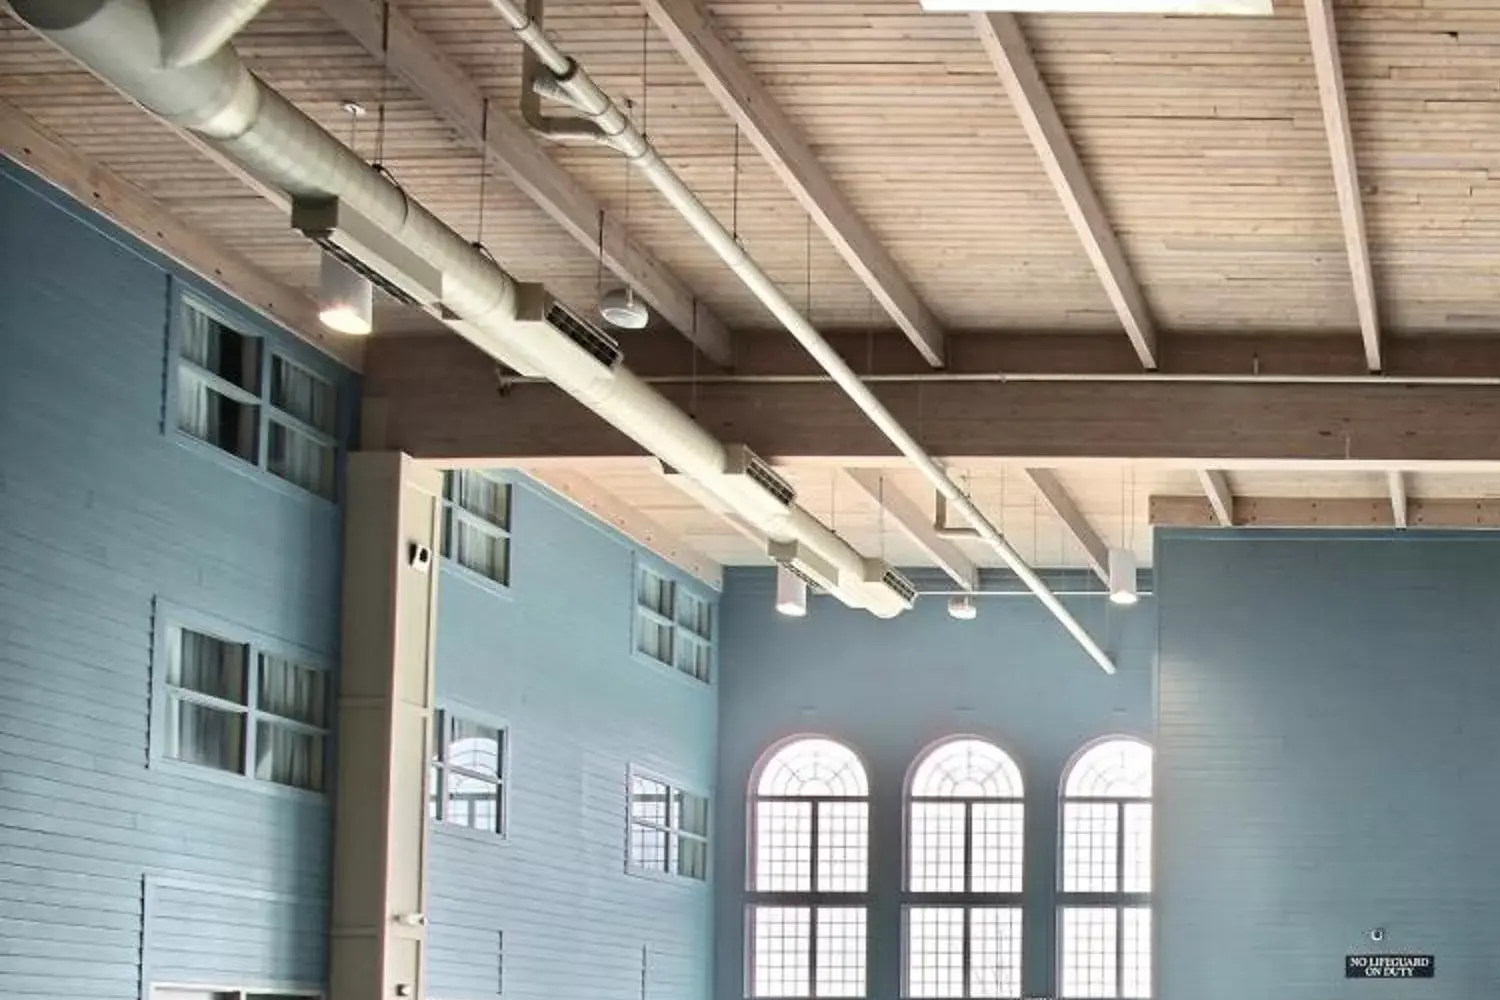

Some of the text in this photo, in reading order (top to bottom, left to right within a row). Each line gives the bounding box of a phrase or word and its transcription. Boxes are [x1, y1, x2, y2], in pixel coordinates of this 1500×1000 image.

[1350, 957, 1429, 967] NO LIFEGUARD
[1365, 967, 1414, 977] ON DUTY
